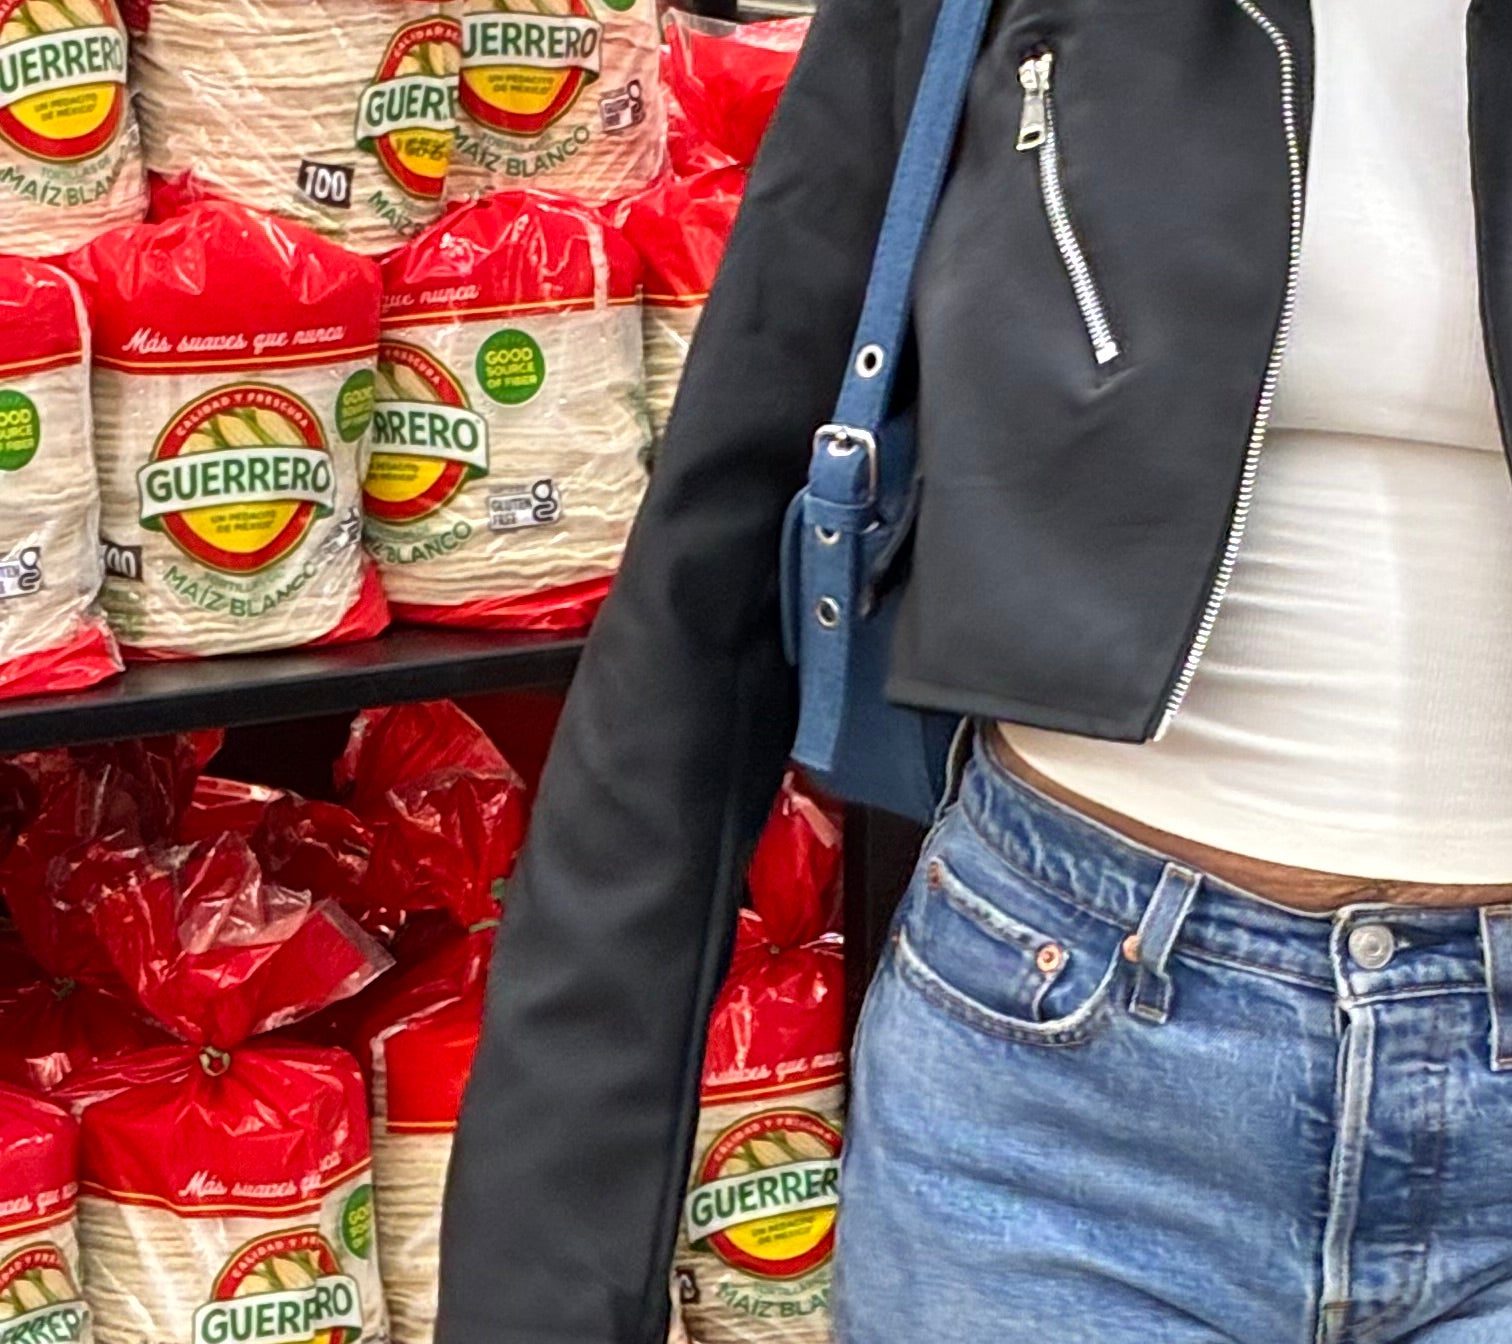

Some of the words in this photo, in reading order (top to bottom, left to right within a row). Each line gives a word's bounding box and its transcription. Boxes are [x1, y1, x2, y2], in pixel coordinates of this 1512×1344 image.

[505, 125, 591, 179] BLANCO
[305, 167, 349, 199] 100
[420, 284, 479, 305] nunca
[122, 328, 172, 354] Más
[177, 334, 247, 353] suaves
[252, 332, 288, 356] que
[484, 347, 533, 365] GOOD
[486, 362, 534, 376] SOURCE
[487, 377, 503, 389] OF
[146, 457, 332, 504] GUERRERO
[163, 566, 223, 609] MAÍZ
